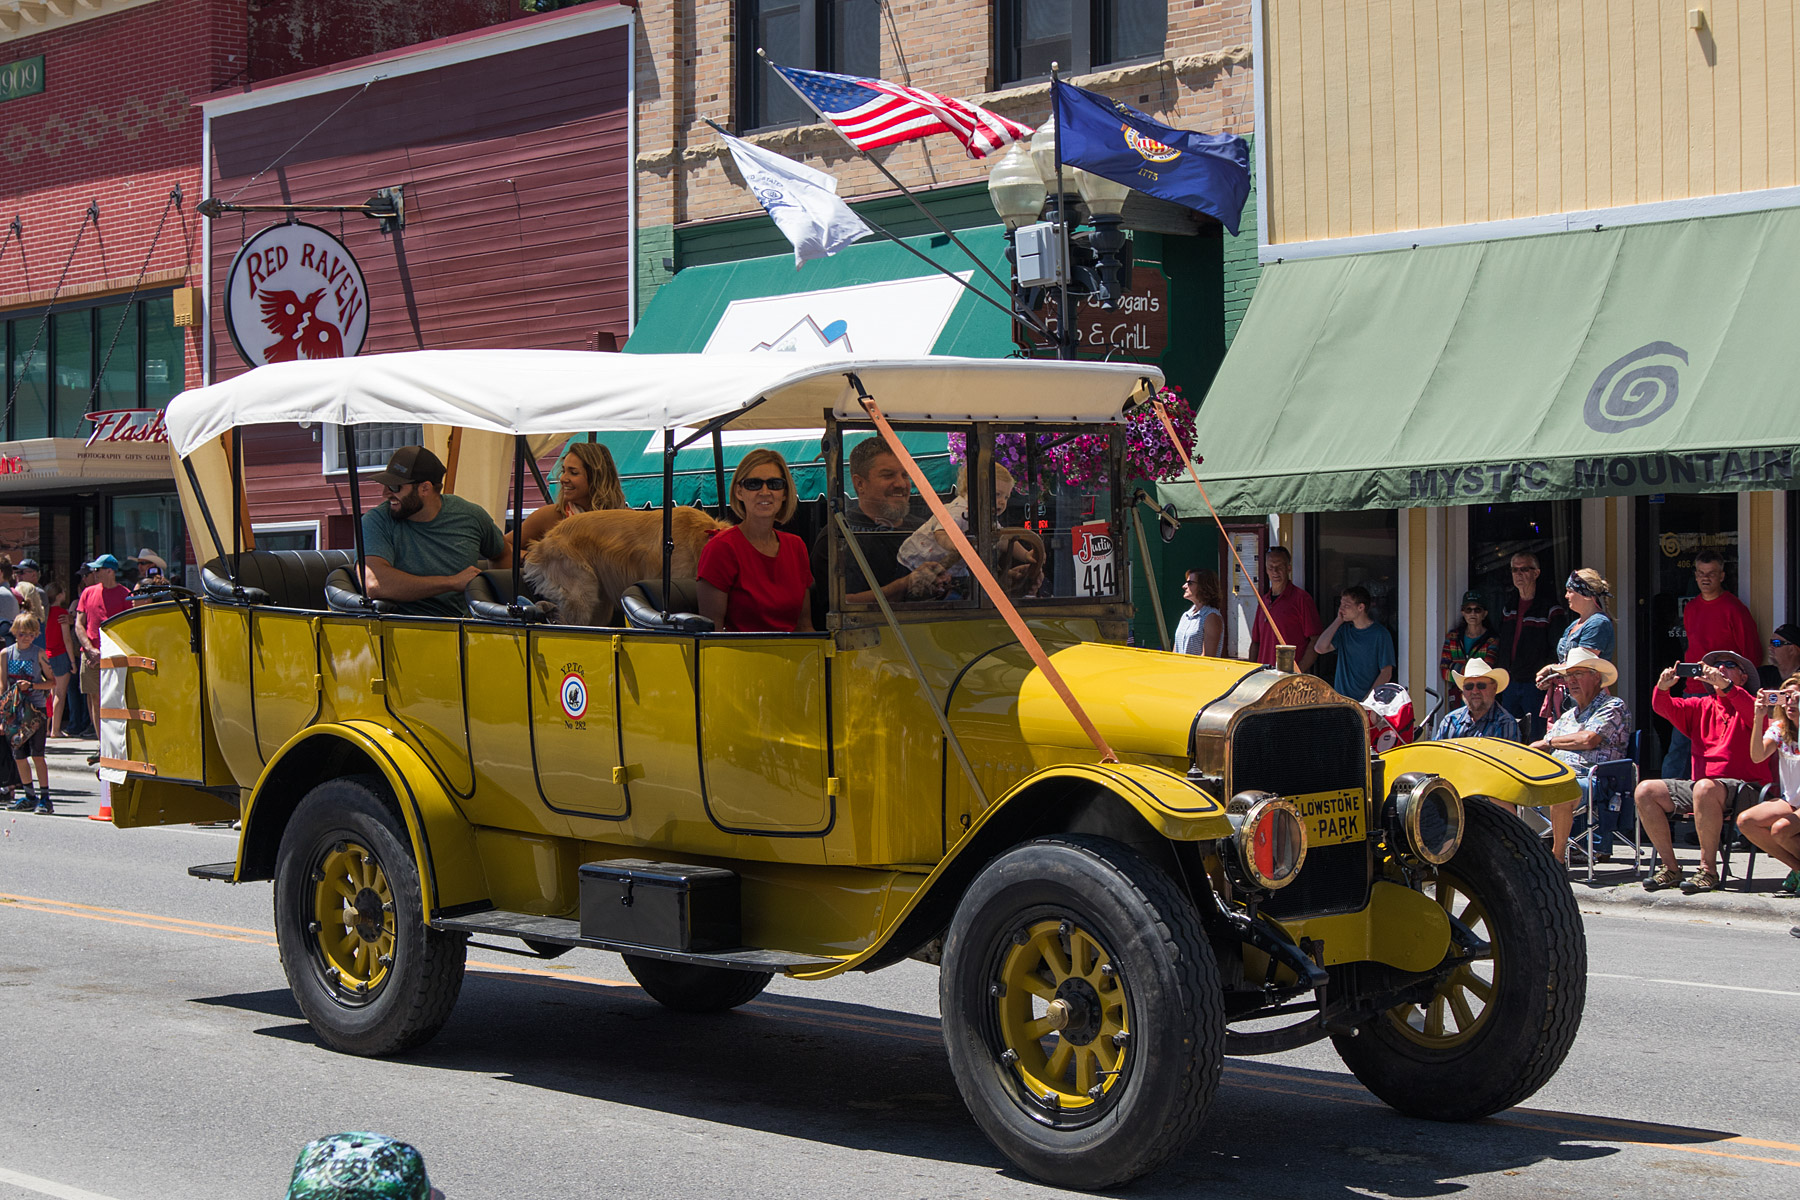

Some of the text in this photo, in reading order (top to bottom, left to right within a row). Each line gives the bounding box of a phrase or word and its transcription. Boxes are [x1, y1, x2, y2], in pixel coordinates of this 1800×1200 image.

[0, 63, 37, 95] 909
[1138, 168, 1158, 181] 1775
[246, 243, 362, 336] RED RAVEN
[1116, 290, 1160, 314] ogan's
[1110, 323, 1151, 355] Grill
[77, 452, 121, 460] PHOTOGRAPHY
[1409, 450, 1793, 498] MYSTIC MOUNTAIN
[1078, 532, 1113, 563] Justin
[1083, 563, 1115, 597] 414
[574, 720, 587, 731] 282
[1295, 796, 1360, 817] LOWSTONE
[1319, 816, 1359, 839] PARK
